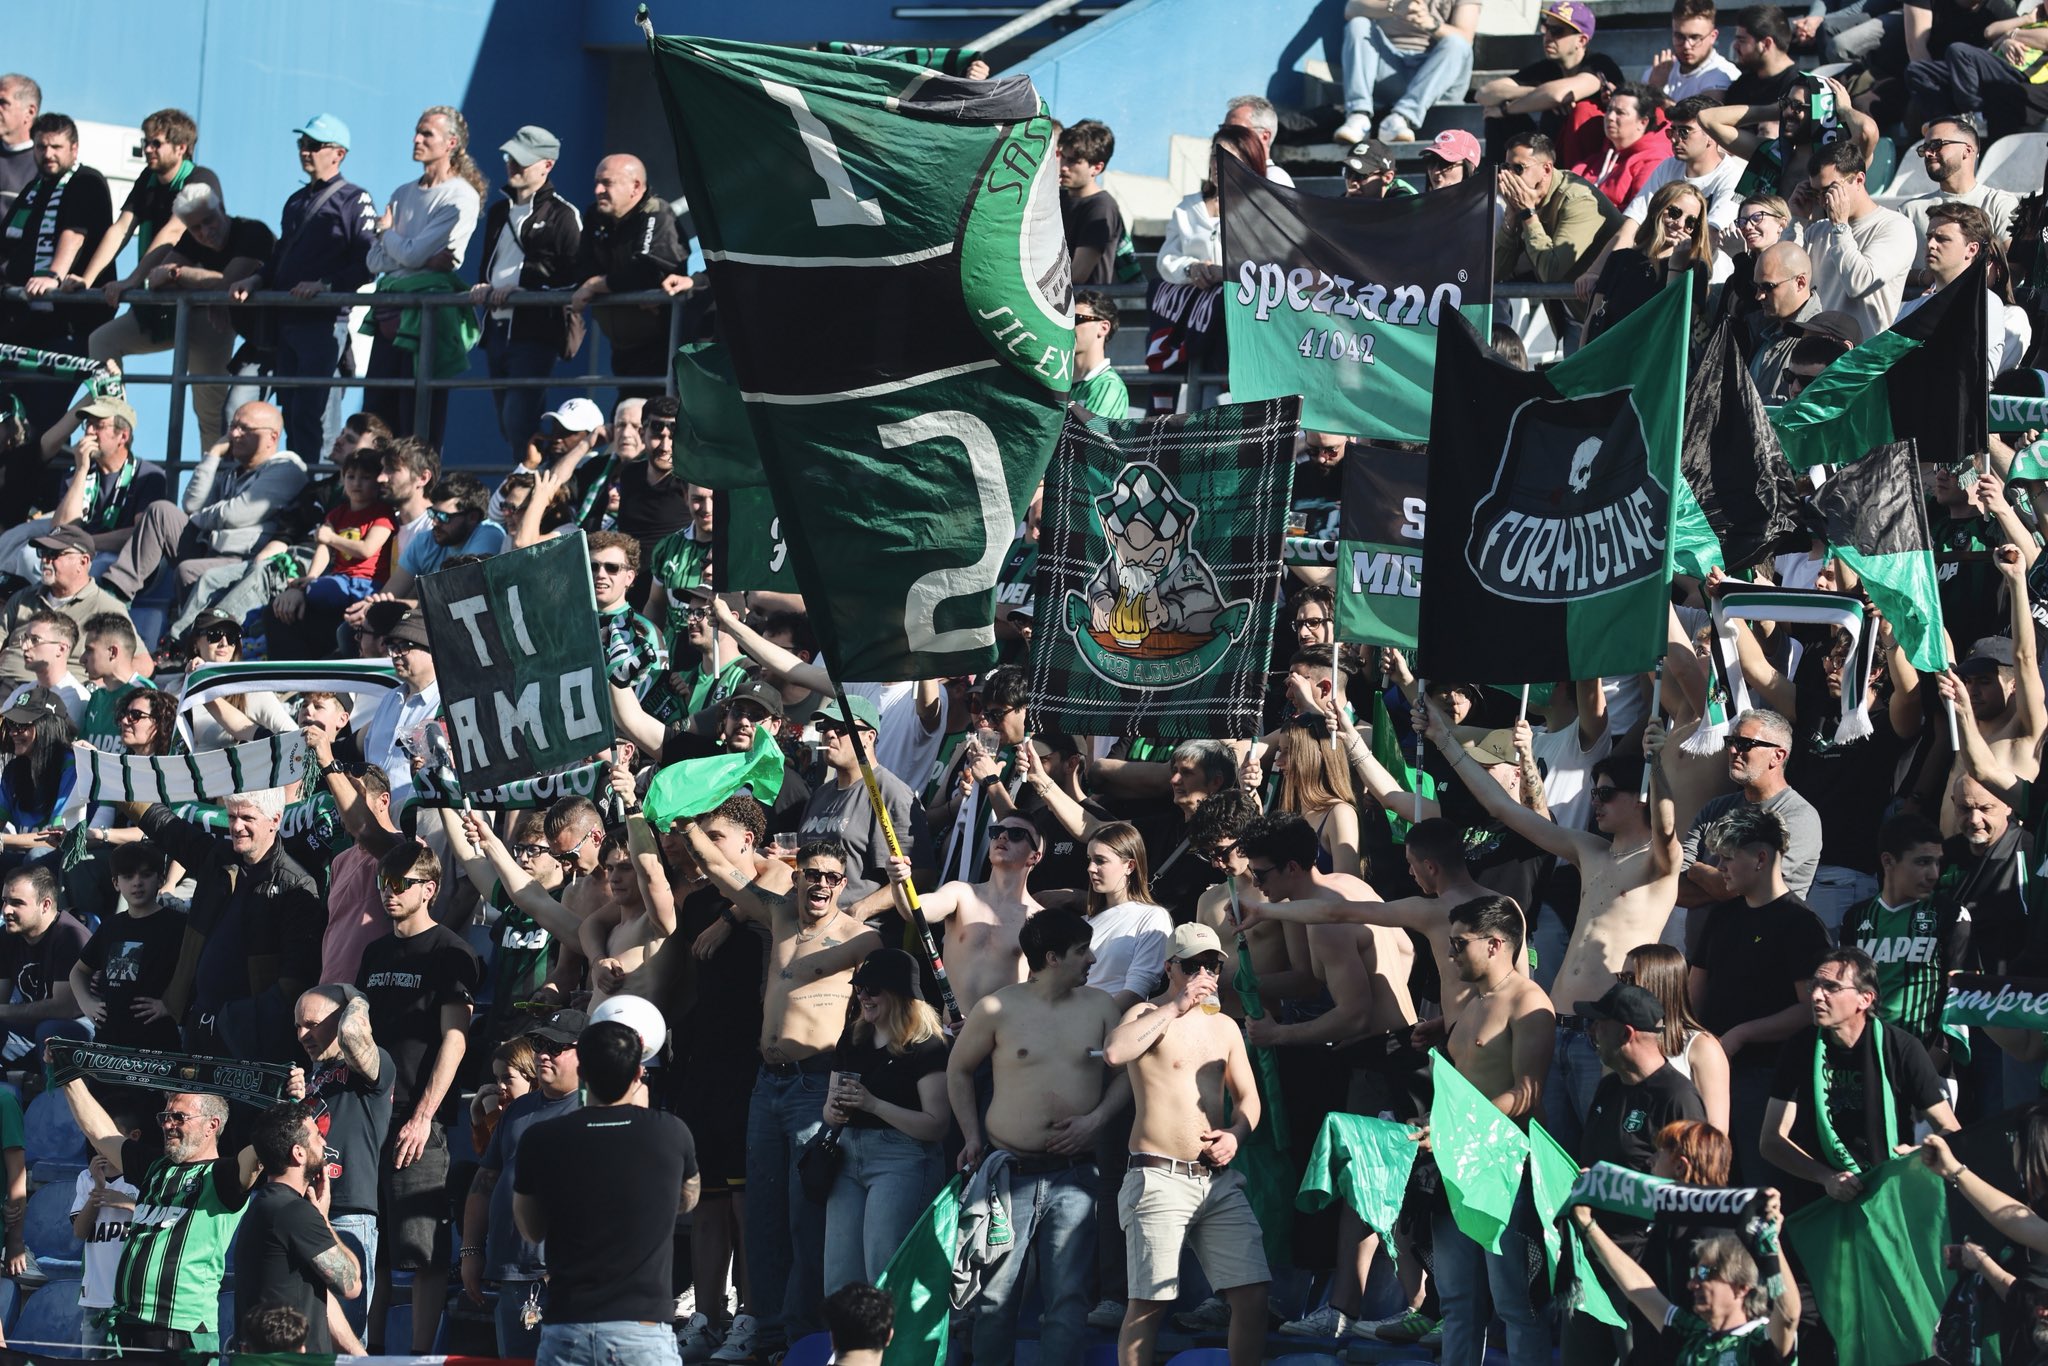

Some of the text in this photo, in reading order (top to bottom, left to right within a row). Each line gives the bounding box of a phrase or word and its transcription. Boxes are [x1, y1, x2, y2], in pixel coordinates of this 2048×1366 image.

[759, 78, 886, 226] 1
[979, 306, 1037, 356] SIC
[1298, 328, 1376, 365] 41042
[877, 410, 1016, 652] 2
[1479, 486, 1667, 592] FORMIGINE
[448, 585, 537, 667] TI
[449, 666, 602, 773] AMO
[1856, 937, 1937, 963] MAPEI
